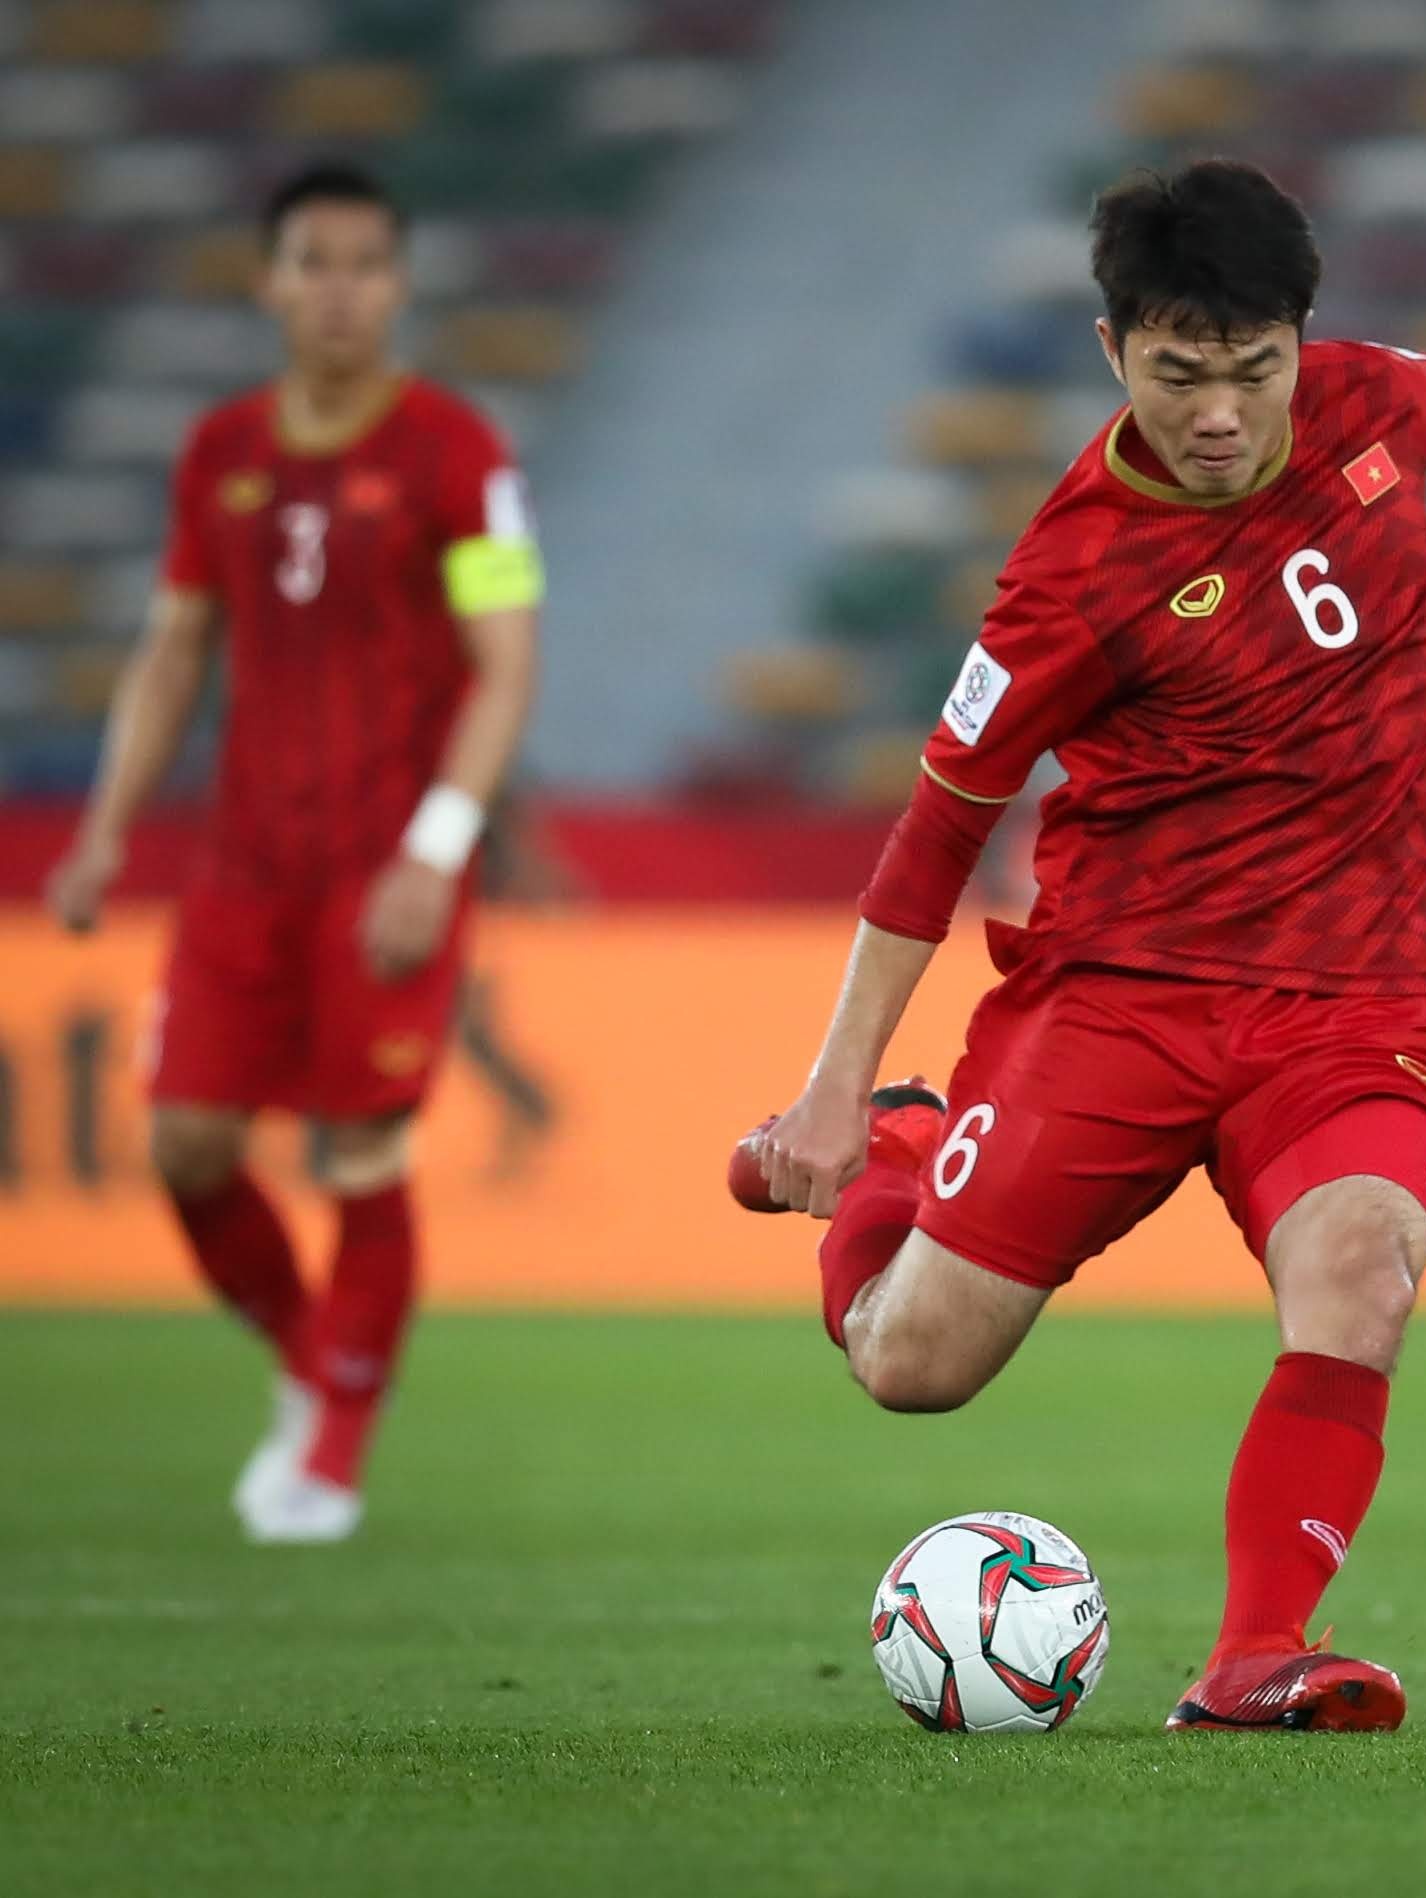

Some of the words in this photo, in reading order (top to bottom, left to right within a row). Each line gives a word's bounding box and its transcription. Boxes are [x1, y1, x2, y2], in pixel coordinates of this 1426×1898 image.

[276, 502, 330, 604] 3
[1281, 547, 1359, 650] 6
[932, 1102, 996, 1200] 6
